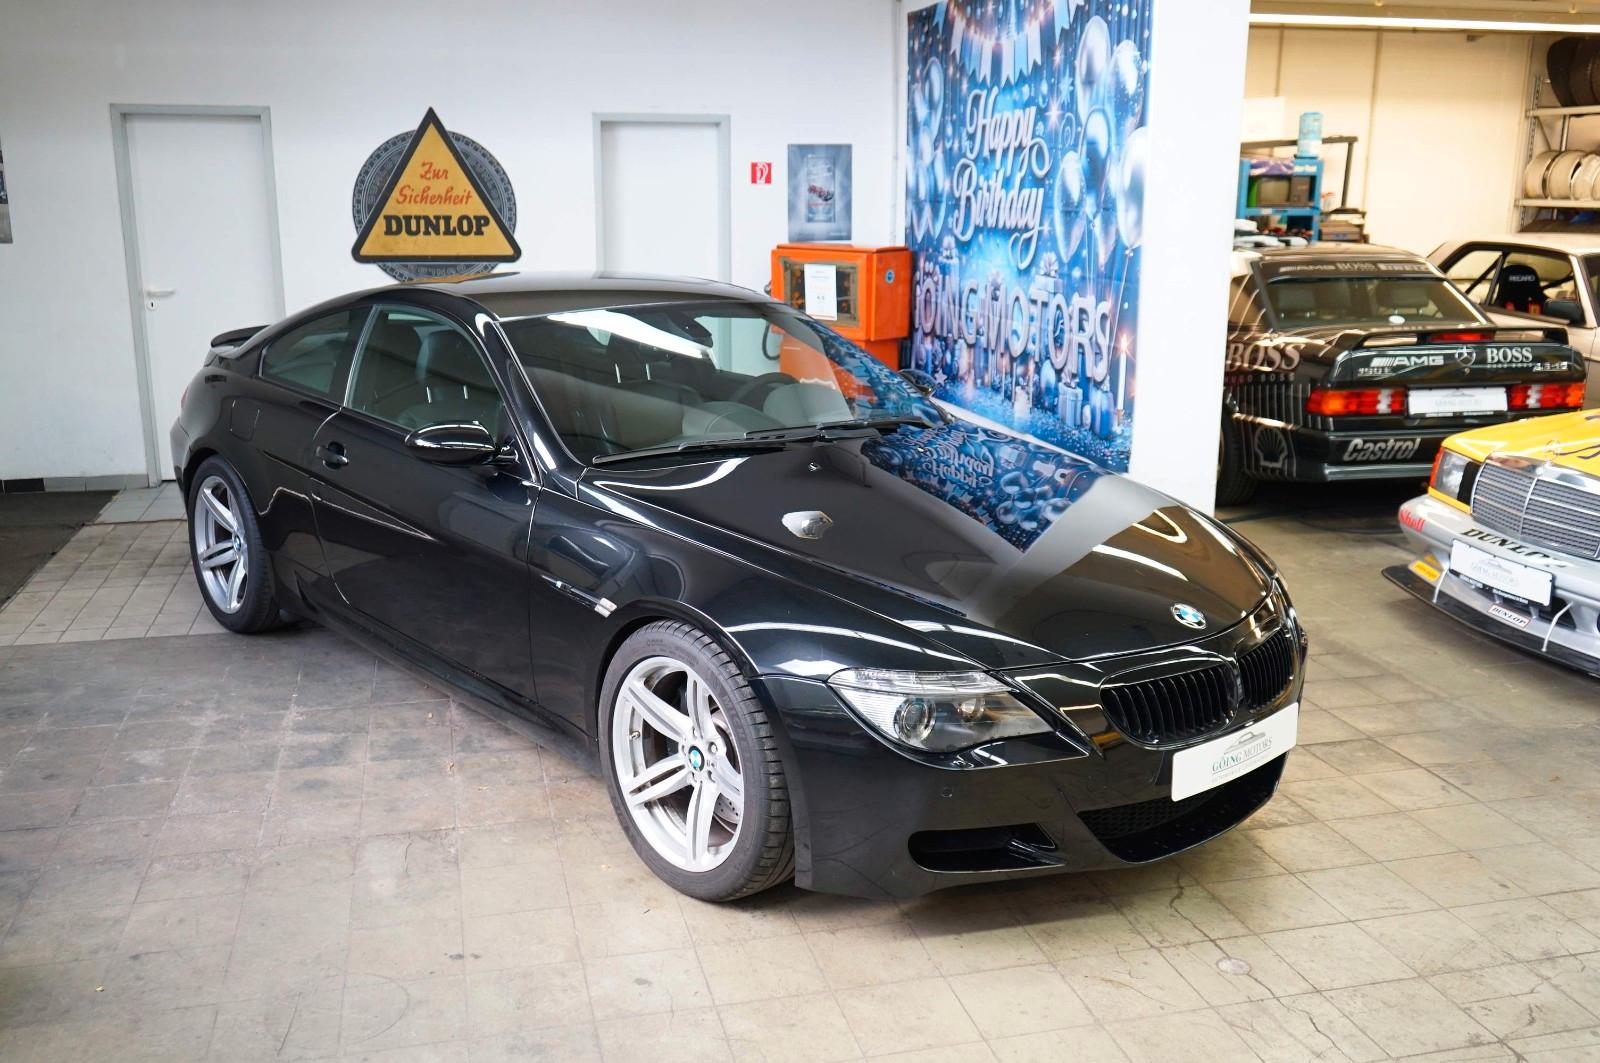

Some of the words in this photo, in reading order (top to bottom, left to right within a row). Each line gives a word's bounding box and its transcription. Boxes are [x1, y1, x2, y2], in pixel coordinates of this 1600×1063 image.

[964, 88, 1052, 178] Happy
[419, 162, 449, 181] Zur
[396, 184, 472, 206] Sicherheit
[383, 214, 490, 236] DUNLOP
[953, 158, 1045, 270] Birthday
[983, 280, 1111, 383] MOTORS
[1225, 342, 1306, 371] BOSS
[1393, 355, 1444, 366] AMG
[1486, 346, 1533, 364] BOSS
[1343, 437, 1421, 461] Castrol
[1492, 607, 1527, 626] DUNLOP
